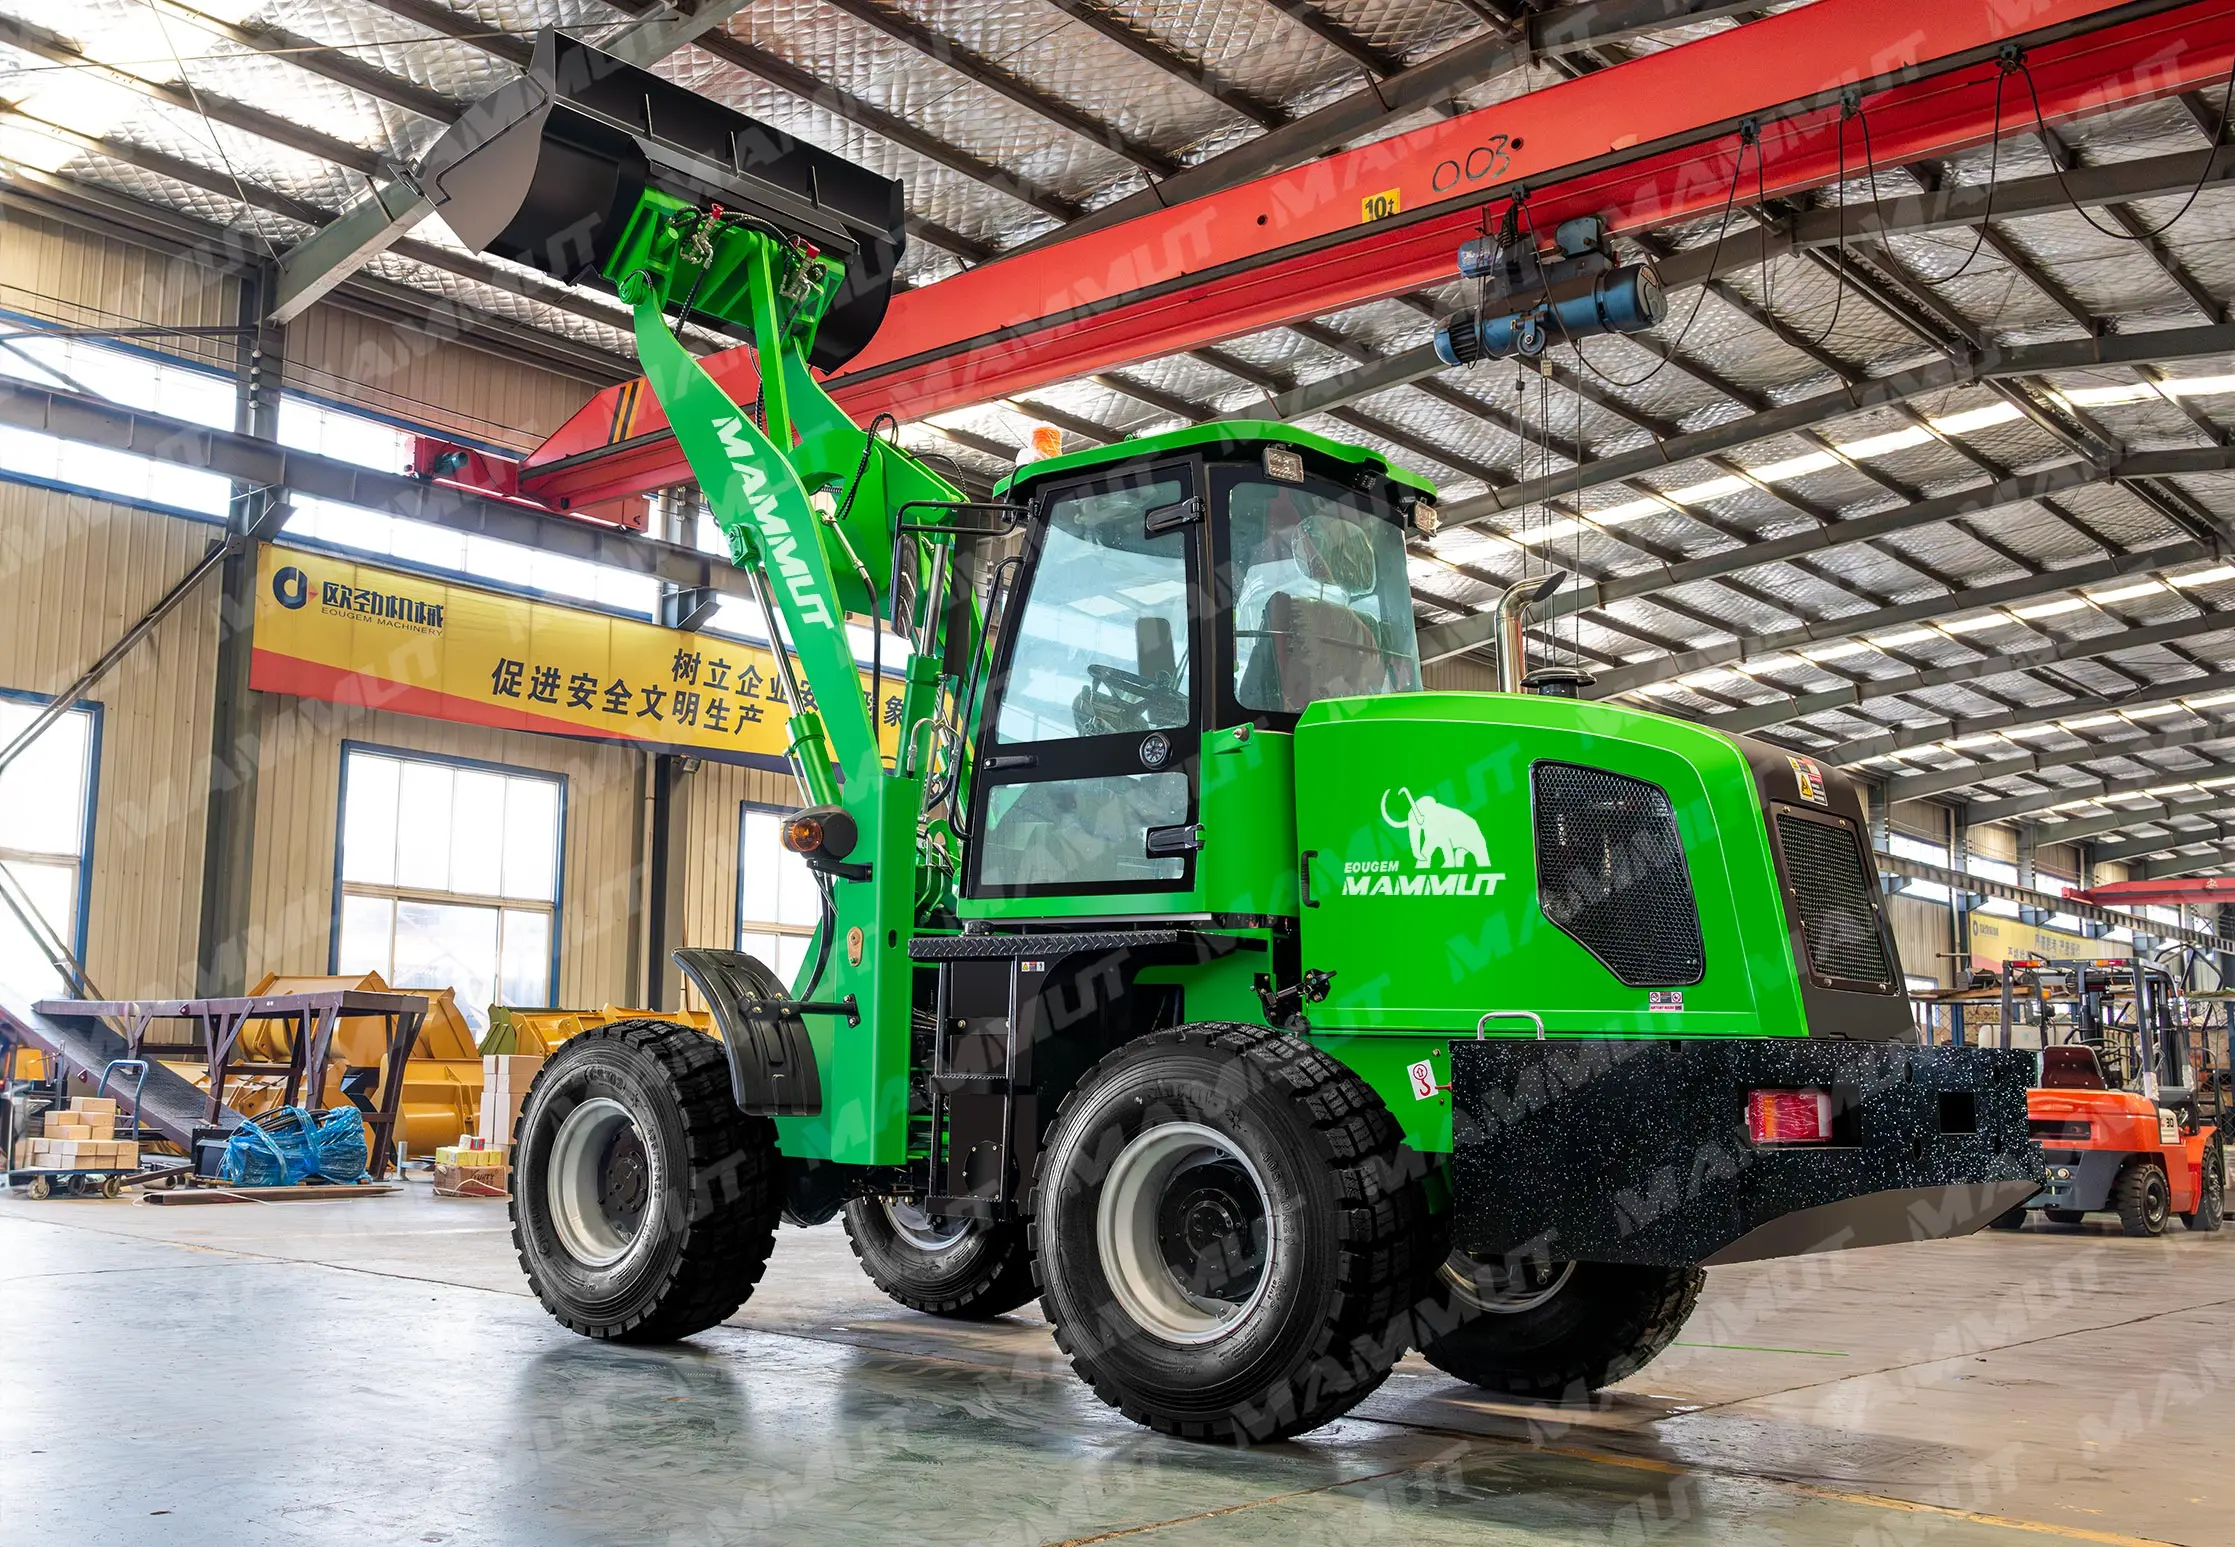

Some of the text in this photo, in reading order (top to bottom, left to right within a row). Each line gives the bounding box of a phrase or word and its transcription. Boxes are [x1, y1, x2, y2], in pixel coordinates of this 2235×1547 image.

[1432, 134, 1511, 193] 003
[1365, 196, 1395, 221] 10t
[711, 416, 834, 630] MAMMUT
[321, 606, 443, 637] EOUGEM MACHINERY
[322, 581, 445, 628] 欧劲机械
[491, 657, 765, 736] 促进安全文明生产
[1341, 872, 1507, 896] MAMMUT
[1344, 861, 1400, 874] EOUGEM
